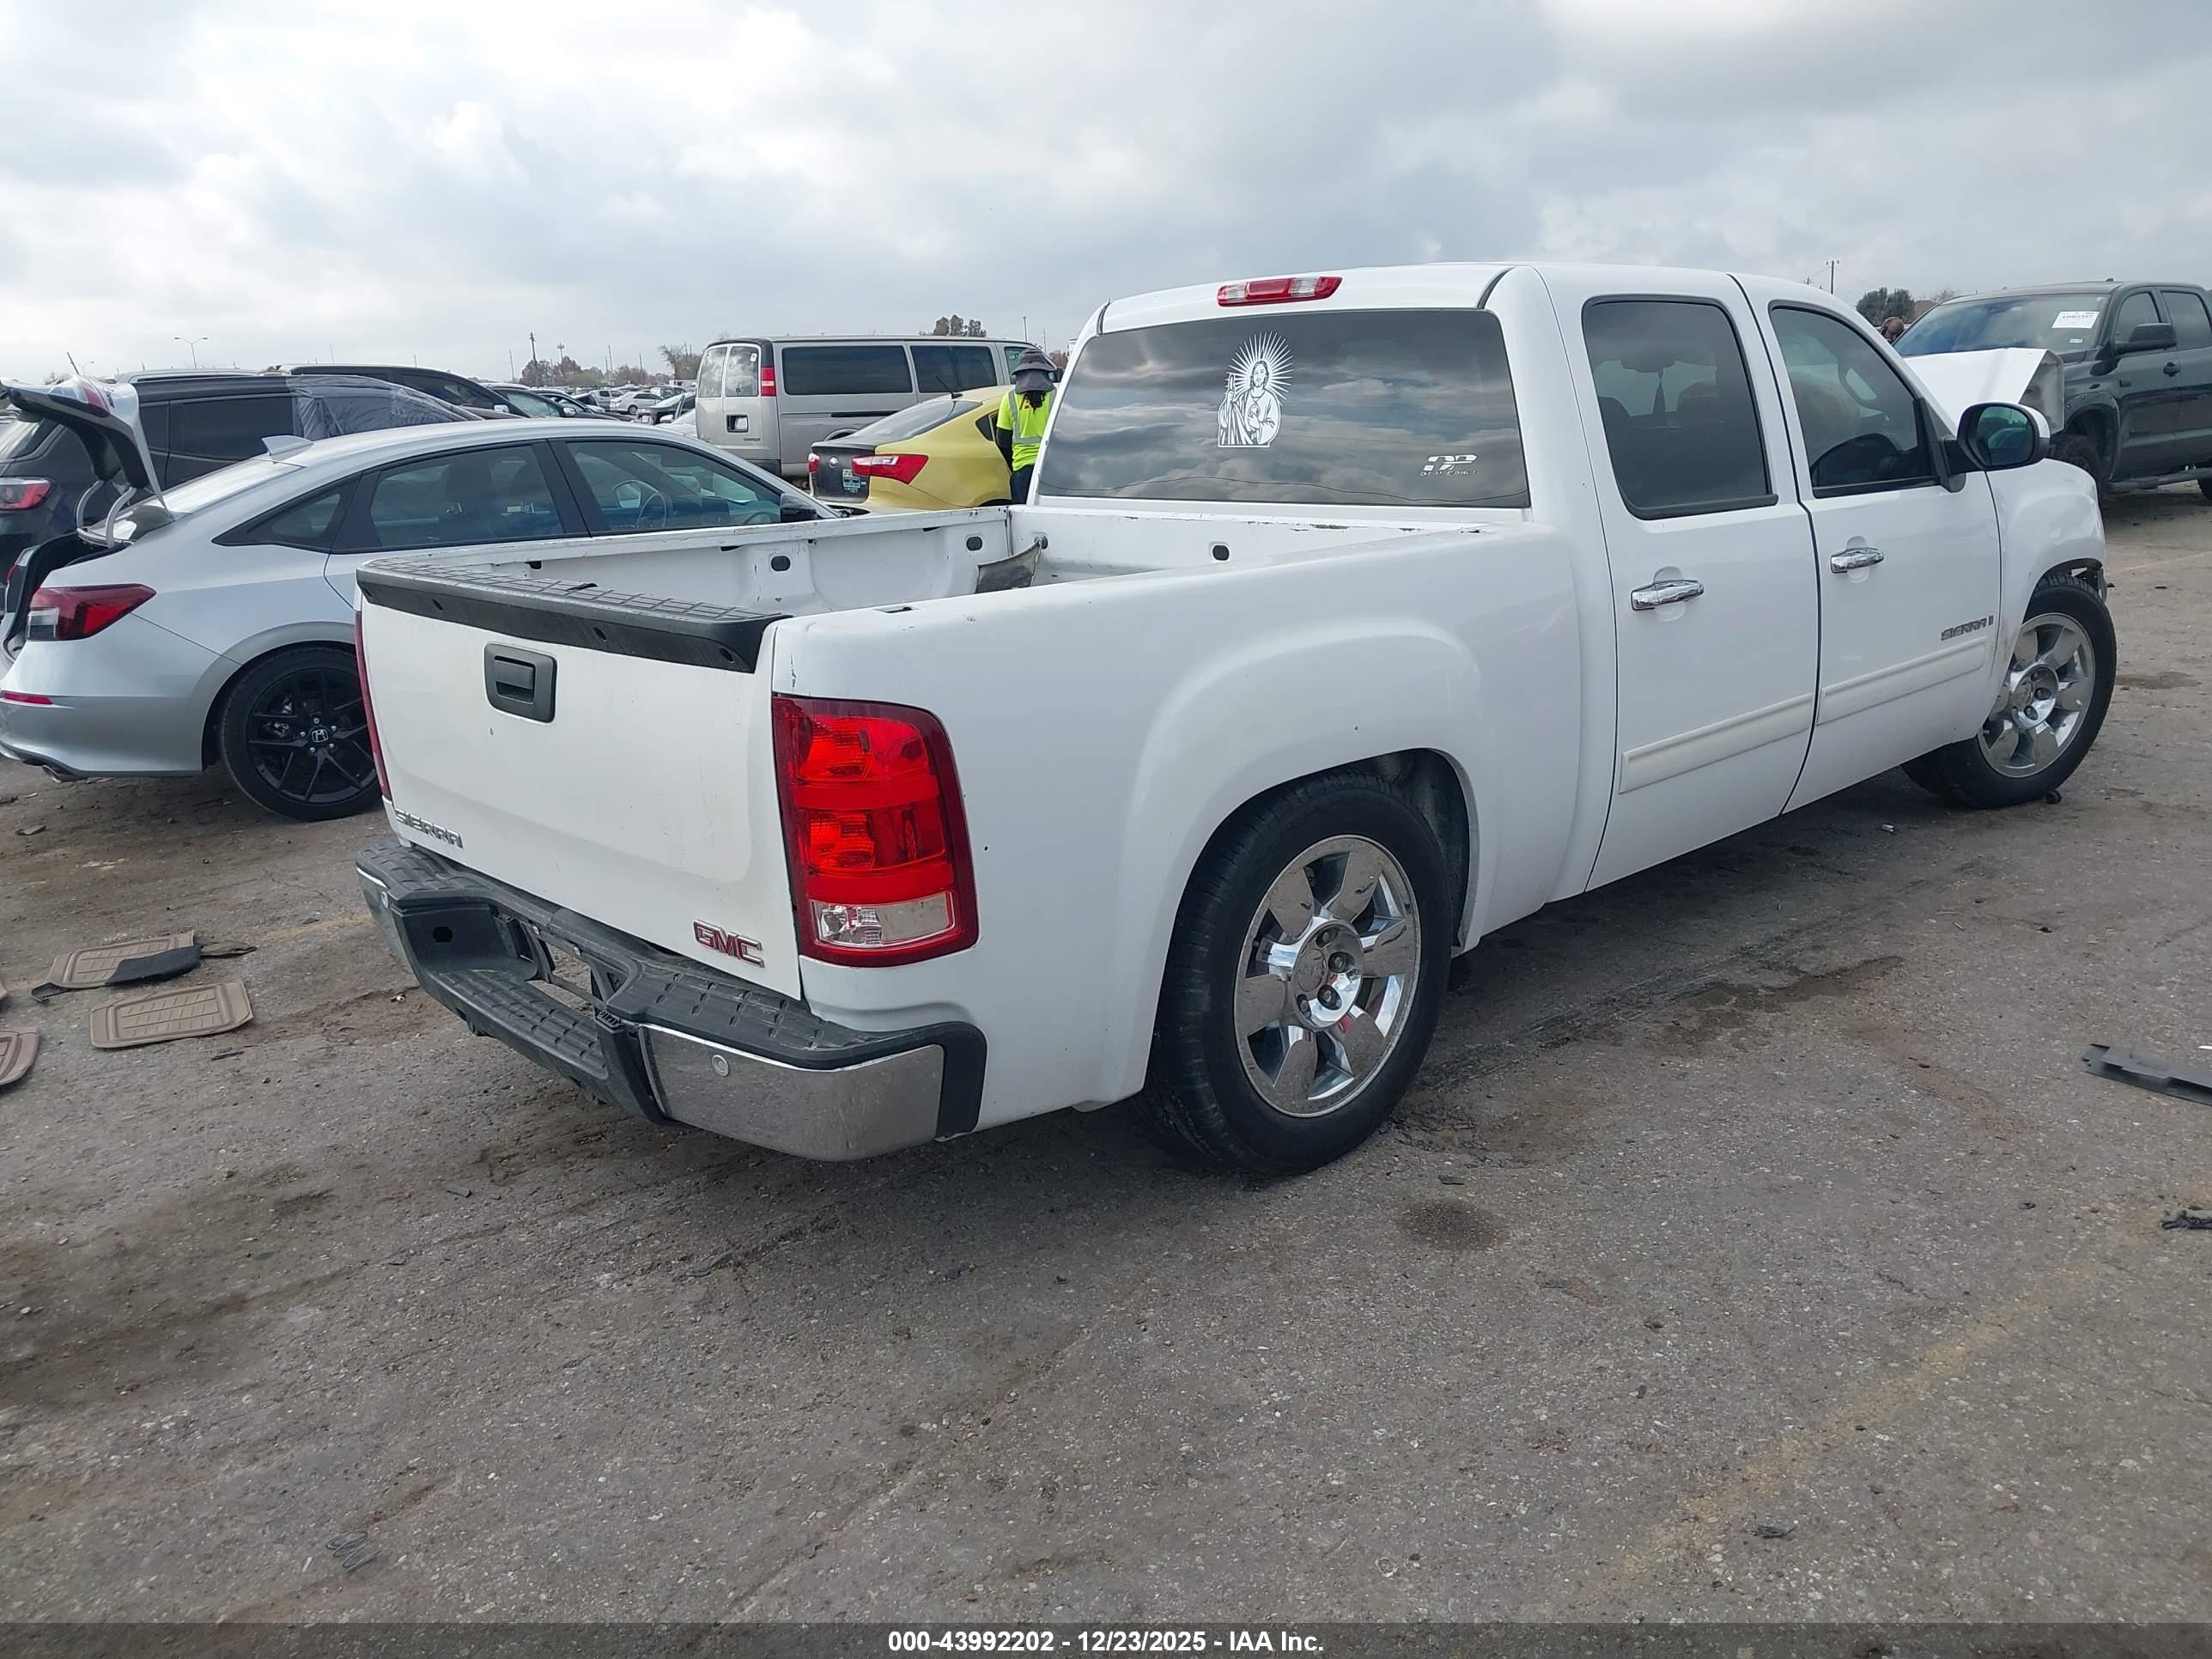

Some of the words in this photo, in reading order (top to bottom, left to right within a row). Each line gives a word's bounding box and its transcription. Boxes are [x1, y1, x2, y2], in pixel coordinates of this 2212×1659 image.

[1941, 617, 1987, 641] SIERRA
[394, 808, 464, 848] SIERRA
[692, 919, 765, 969] GMC
